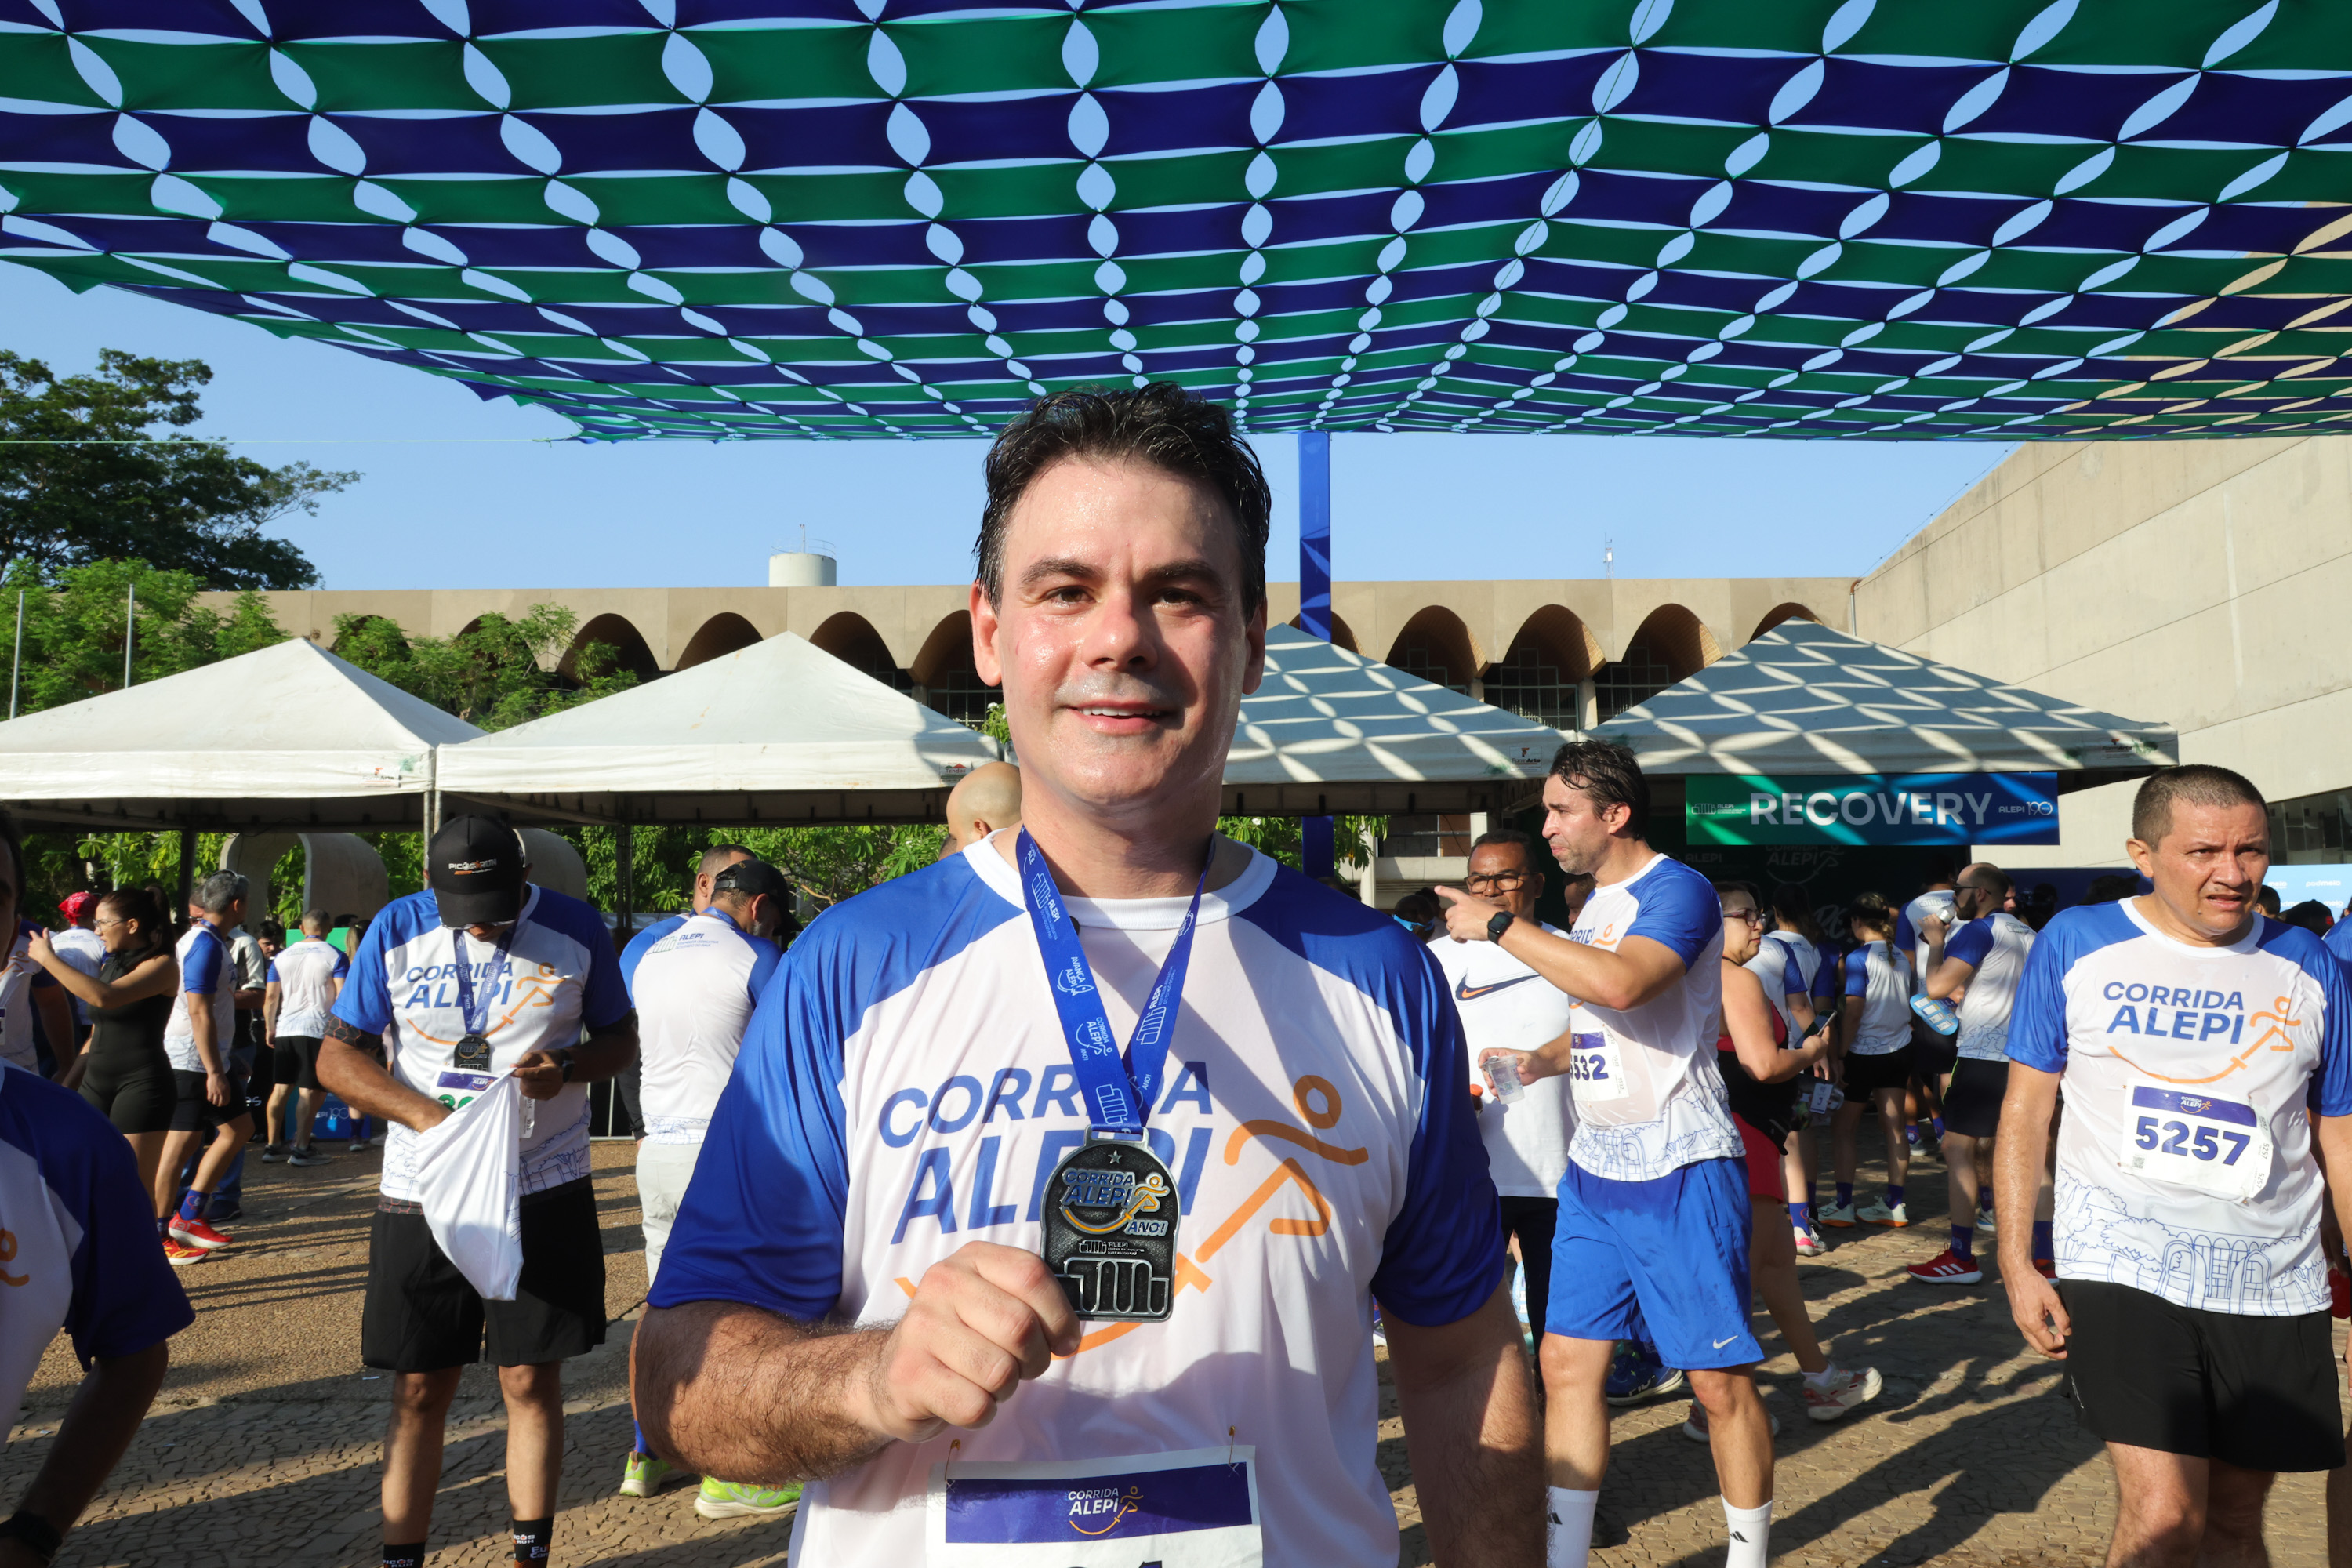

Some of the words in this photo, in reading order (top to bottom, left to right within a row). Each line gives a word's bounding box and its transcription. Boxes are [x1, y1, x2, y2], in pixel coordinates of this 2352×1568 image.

[1751, 792, 1992, 826] RECOVERY
[1685, 853, 1723, 864] ALEPI
[1766, 852, 1818, 866] ALEPI
[1048, 899, 1060, 922] ALEPI
[1065, 969, 1078, 987] ALEPI
[1071, 956, 1085, 983] AVANÇA
[1149, 985, 1163, 1009] ALEPI
[2103, 982, 2244, 1010] CORRIDA
[1086, 1021, 1103, 1045] ALEPI
[1096, 1017, 1110, 1043] CORRIDA
[2106, 1005, 2244, 1044] ALEPI
[2181, 1100, 2202, 1108] ALEPI
[2135, 1116, 2250, 1166] 5257
[1065, 1171, 1134, 1186] CORRIDA
[2256, 1173, 2265, 1188] 5257
[1065, 1185, 1133, 1205] ALEPI
[1127, 1221, 1165, 1233] ANO!
[1068, 1488, 1119, 1500] CORRIDA
[1069, 1498, 1119, 1515] ALEPI
